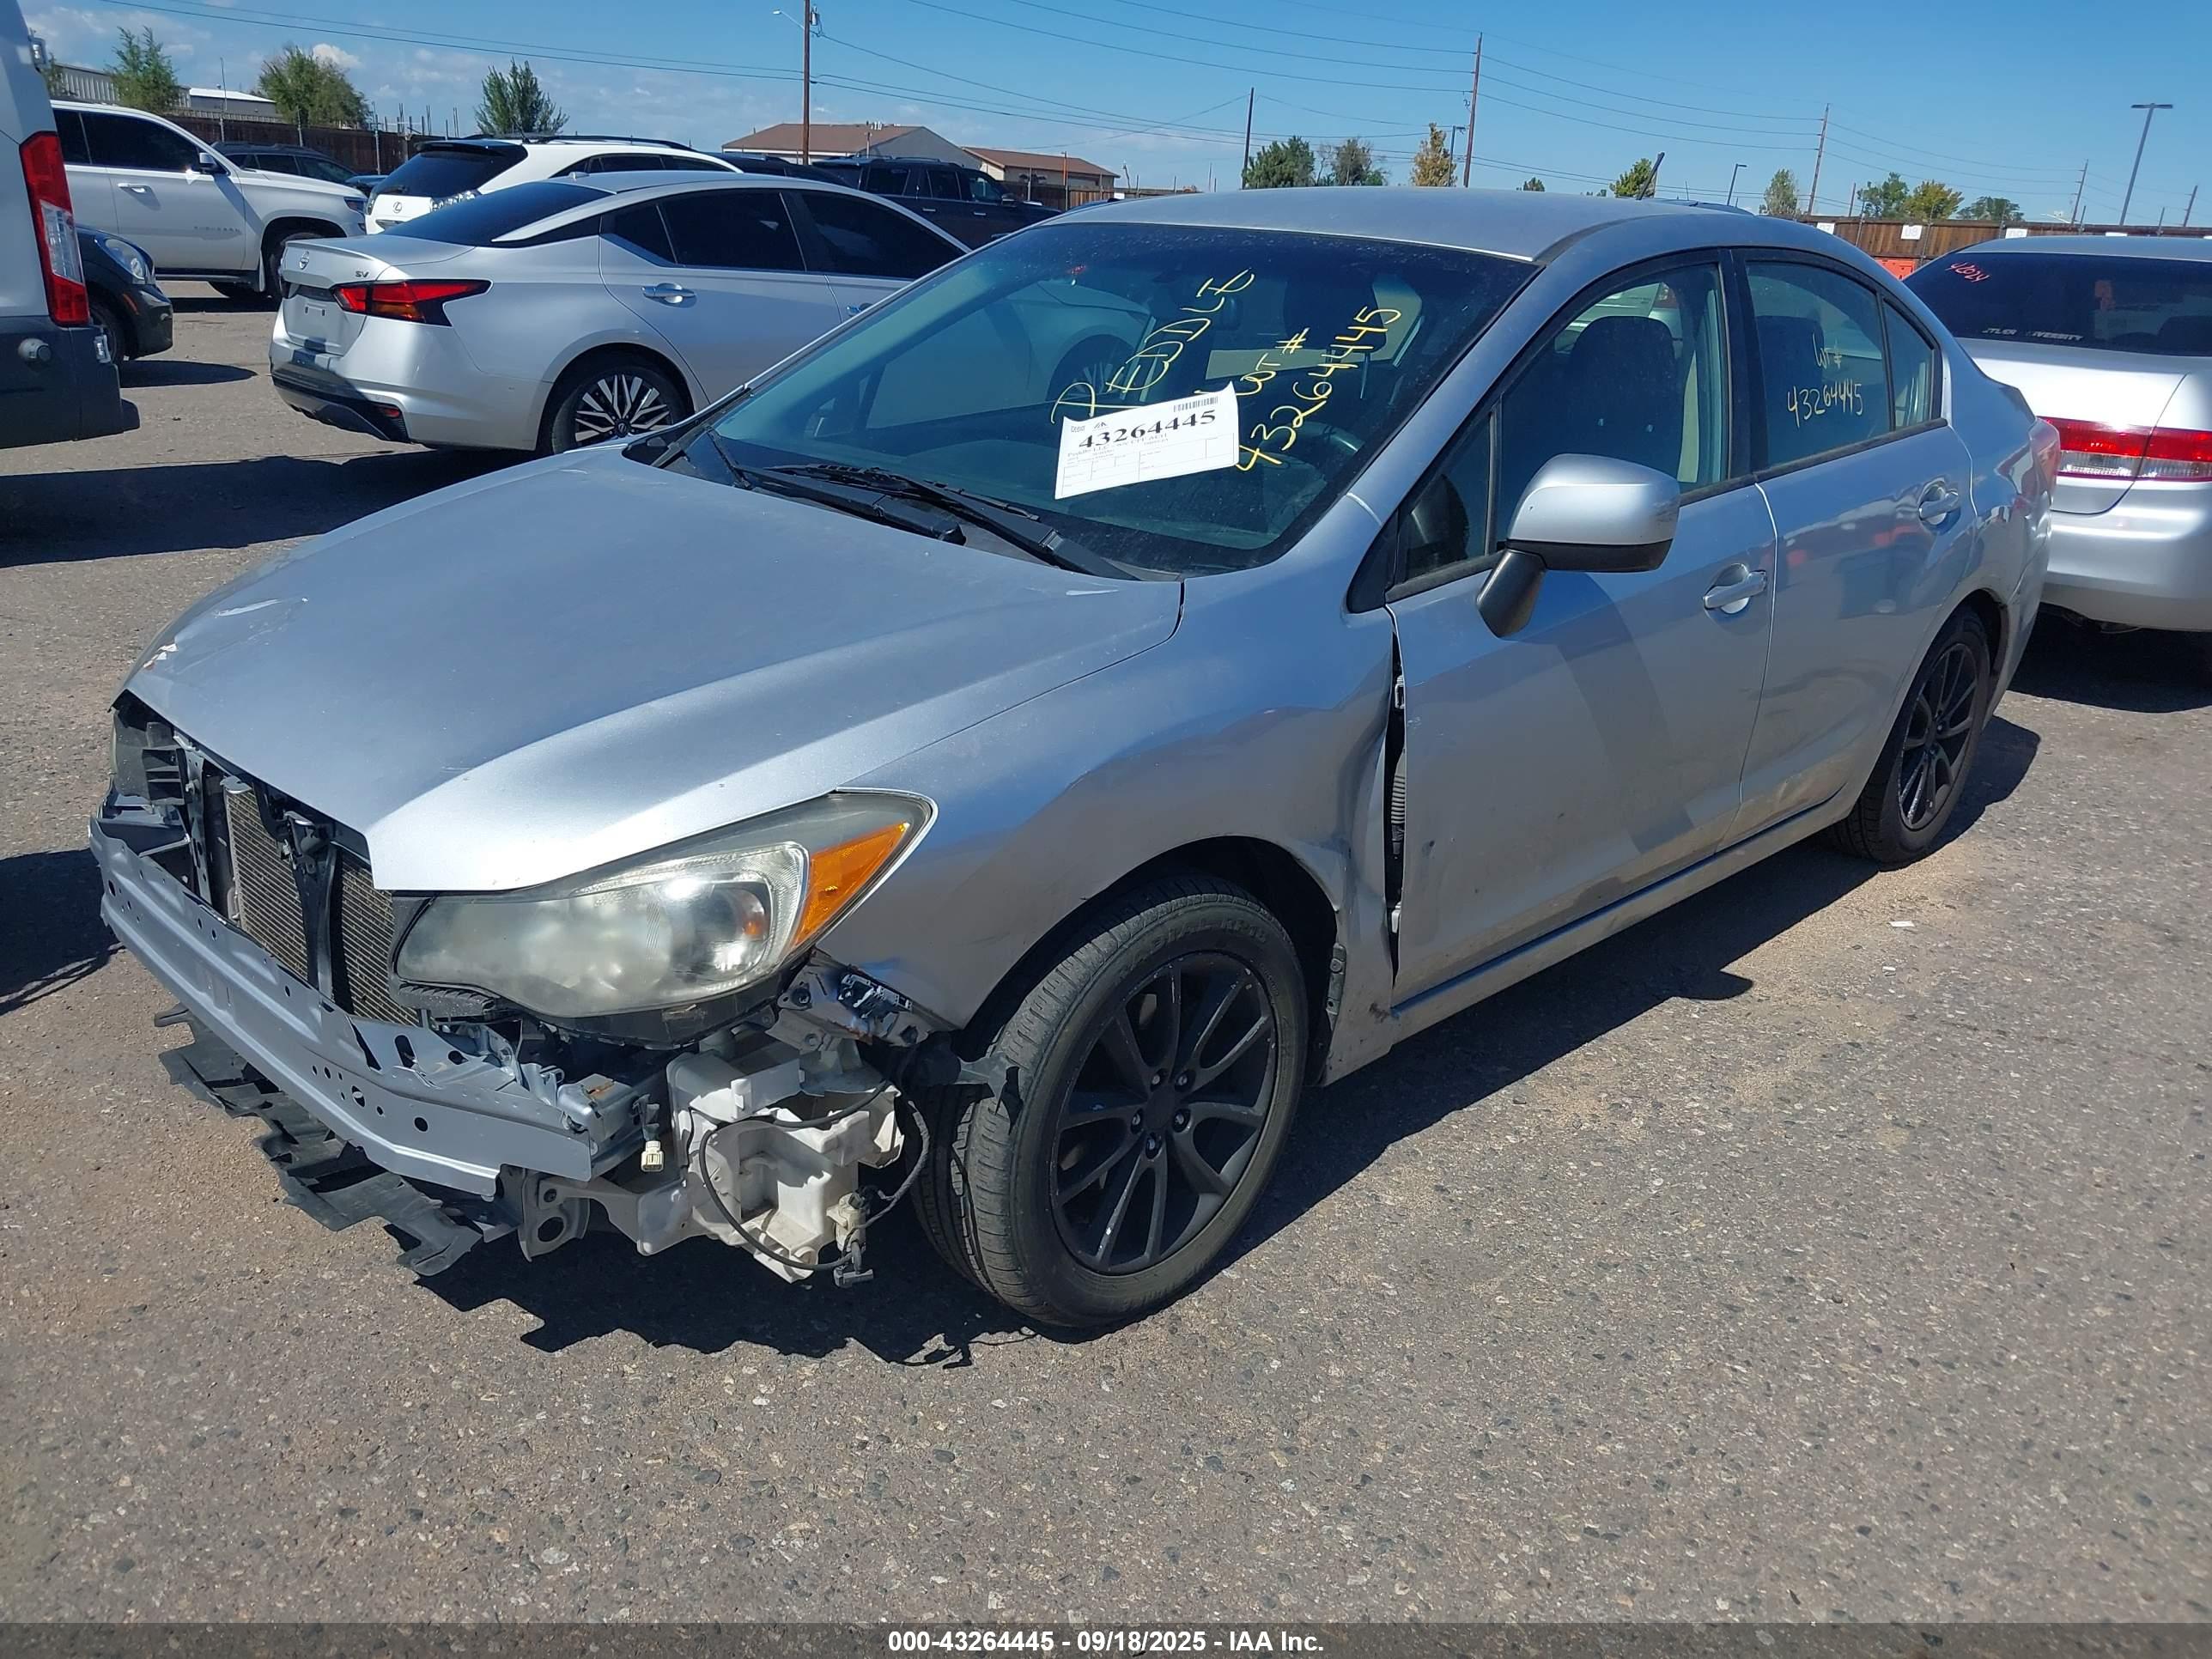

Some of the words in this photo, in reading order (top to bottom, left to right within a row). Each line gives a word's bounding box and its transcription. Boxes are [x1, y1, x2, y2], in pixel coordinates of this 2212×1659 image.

[1274, 327, 1310, 355] #
[1235, 306, 1402, 471] 43264445
[1787, 378, 1863, 429] 43264445
[1079, 409, 1216, 448] 43264445
